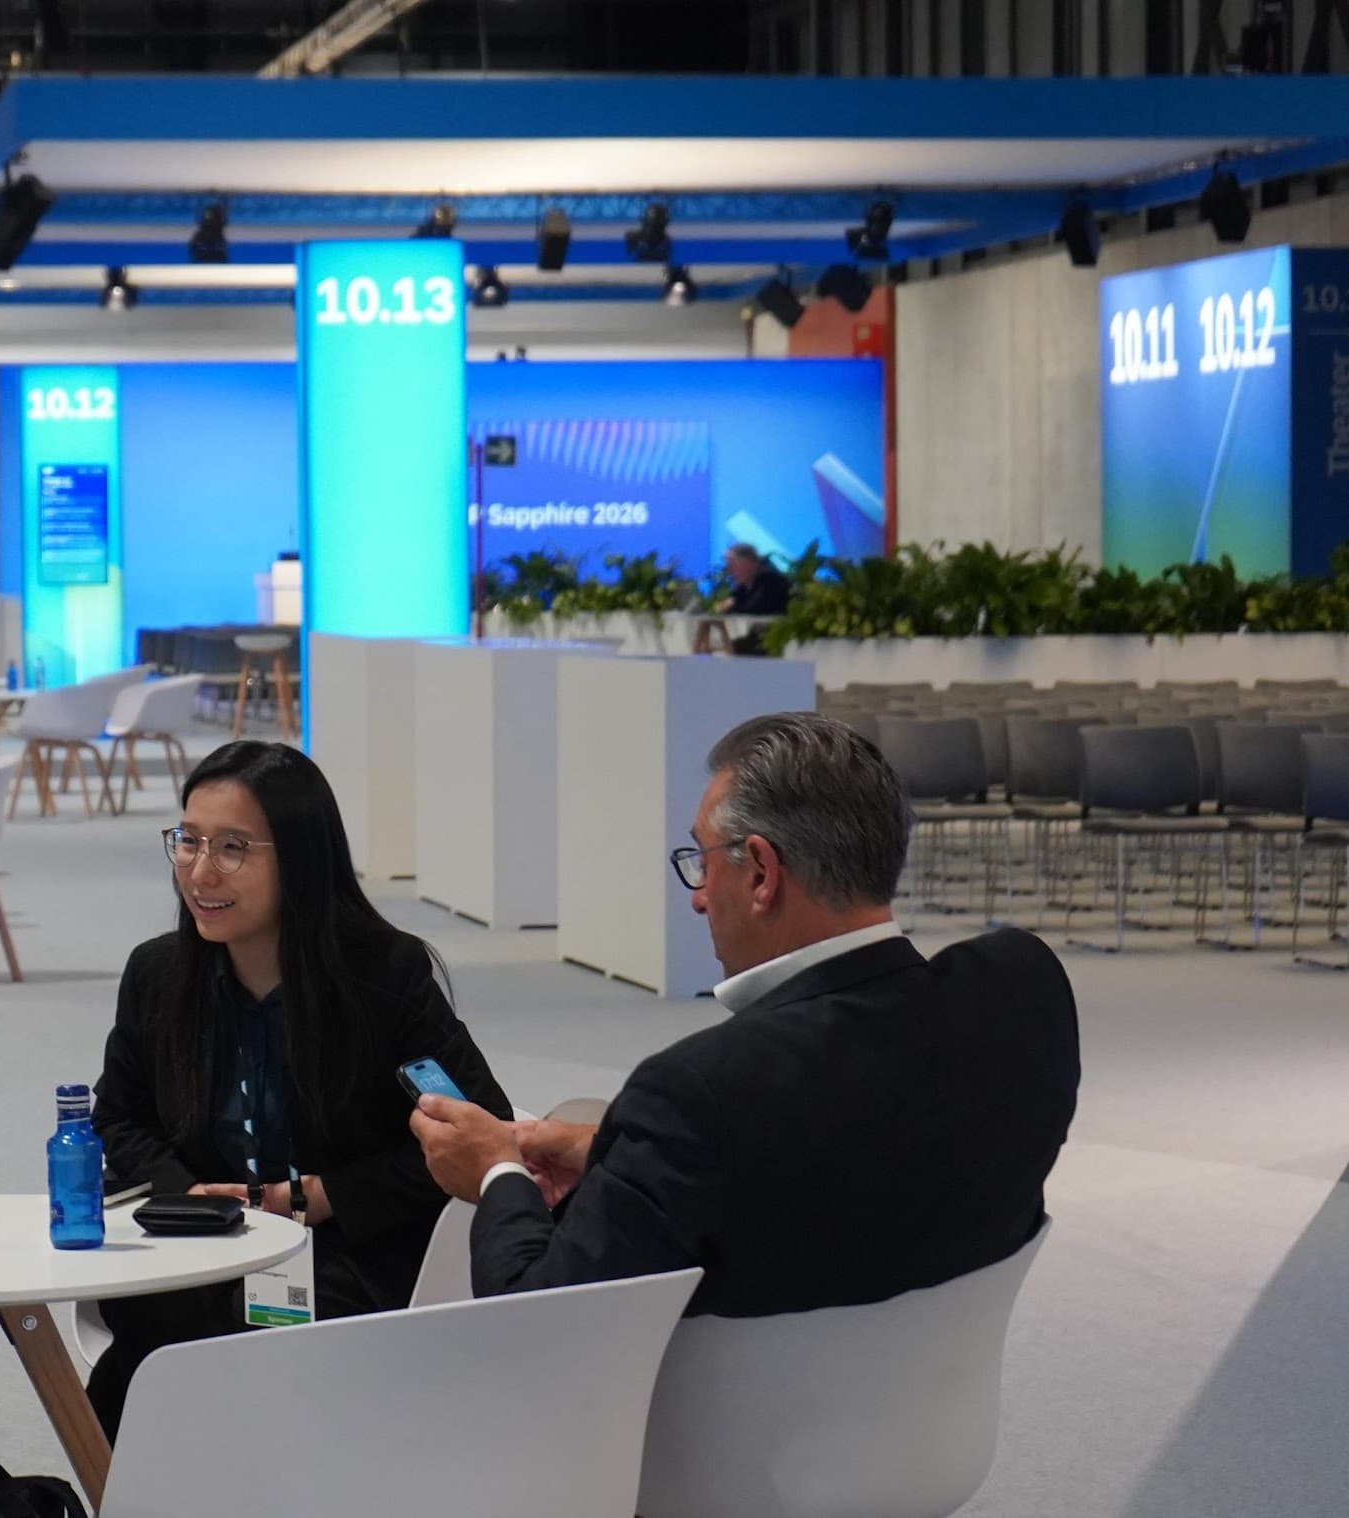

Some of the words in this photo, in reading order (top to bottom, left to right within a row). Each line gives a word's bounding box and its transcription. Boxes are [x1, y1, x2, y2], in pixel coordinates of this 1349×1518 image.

[318, 276, 456, 324] 10.13
[1304, 284, 1349, 312] 10.
[1110, 303, 1178, 384] 10.11
[1199, 286, 1276, 373] 10.12
[27, 387, 116, 419] 10.12
[488, 501, 590, 530] Sapphire
[591, 502, 649, 525] 2026
